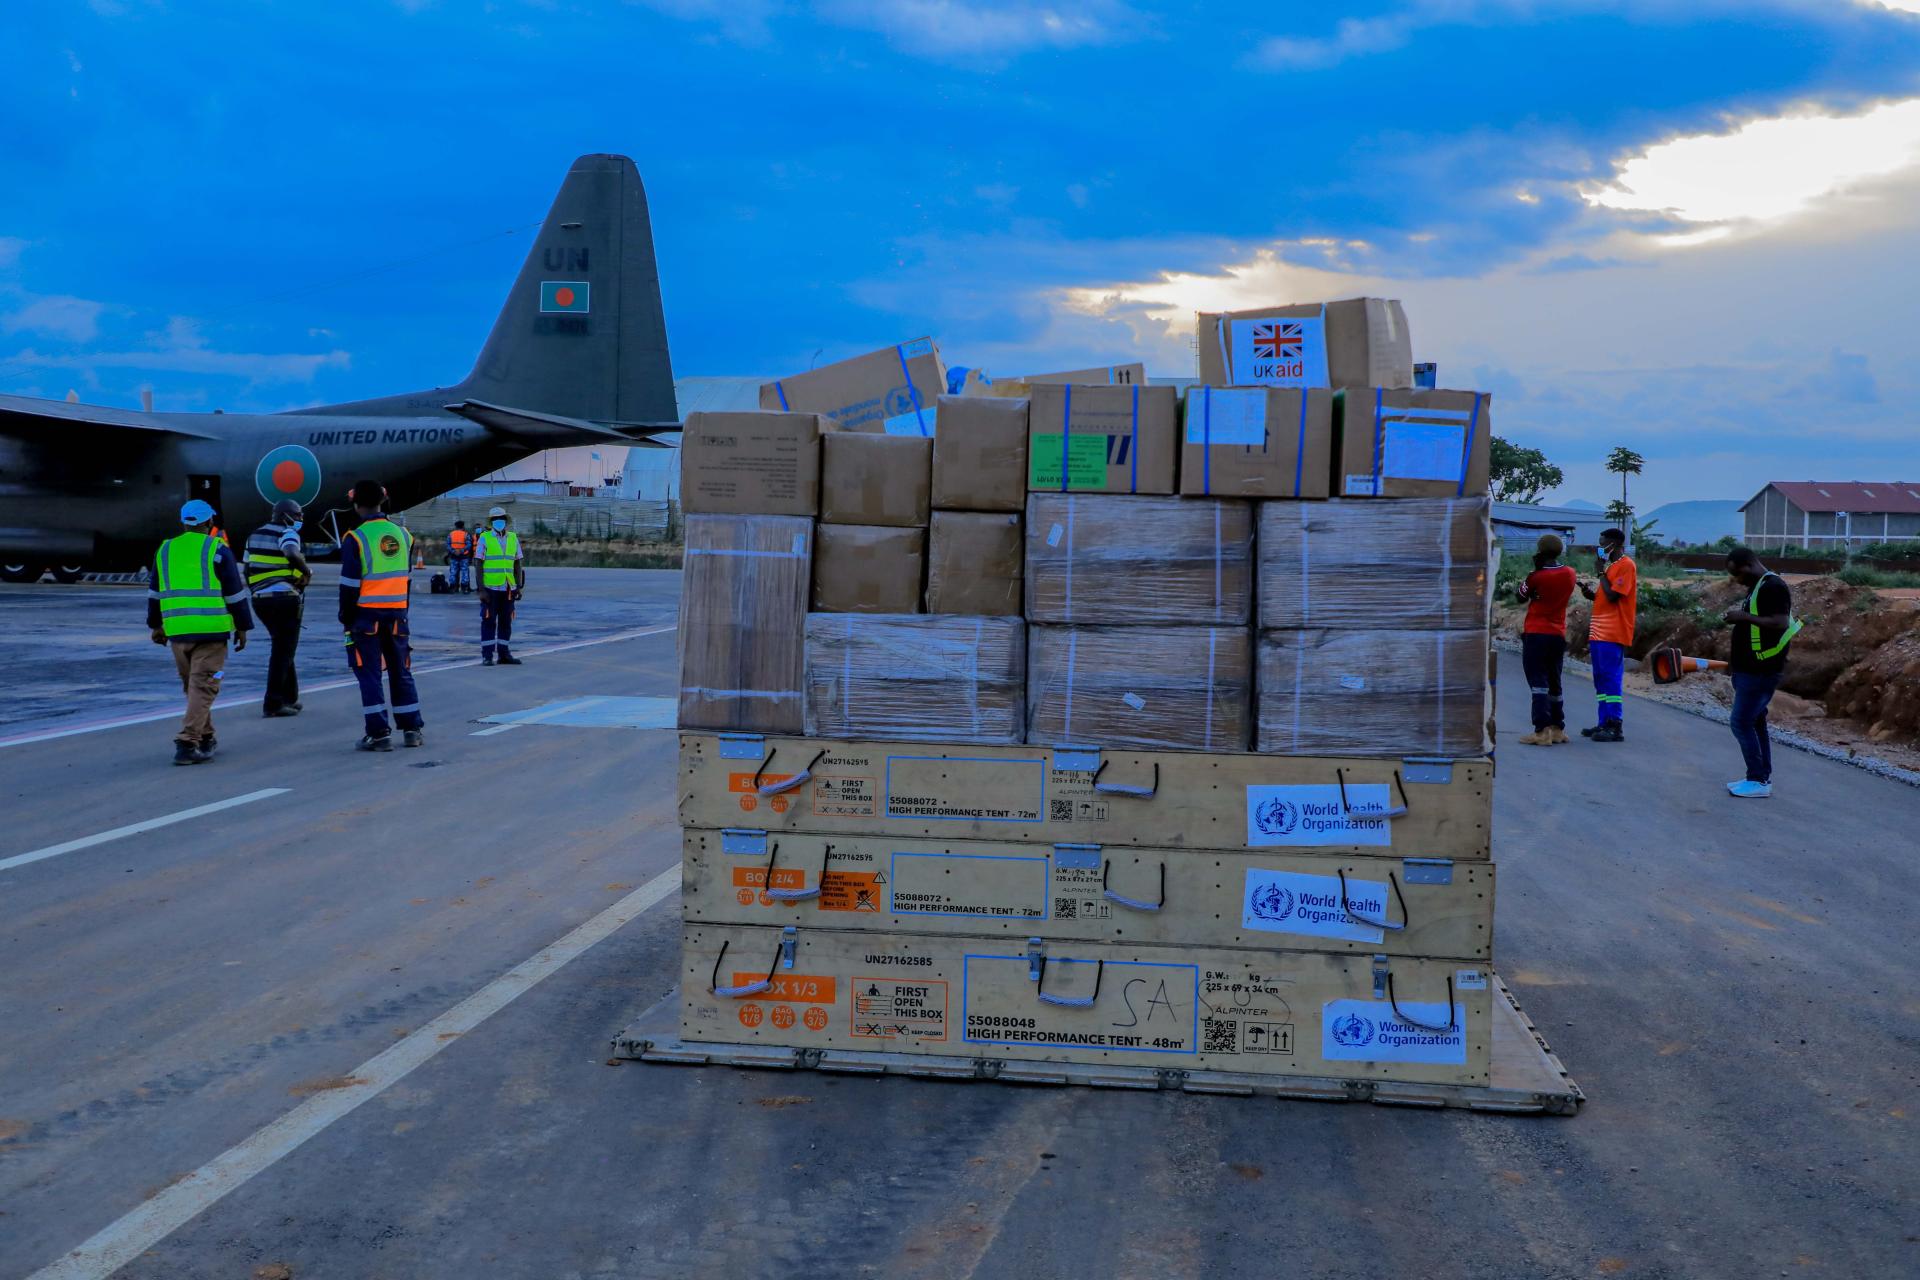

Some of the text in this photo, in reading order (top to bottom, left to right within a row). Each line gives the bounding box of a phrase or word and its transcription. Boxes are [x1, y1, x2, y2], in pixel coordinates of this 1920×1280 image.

[543, 247, 590, 272] UN
[308, 428, 464, 446] UNITED NATIONS
[889, 796, 937, 806] S5088072
[888, 806, 912, 814] HIGH
[914, 807, 983, 817] PERFORMANCE
[986, 809, 1010, 818] TENT
[1302, 802, 1338, 816] World
[1302, 816, 1384, 833] Organization
[776, 873, 794, 884] 2/4
[894, 892, 942, 902] S5088072
[1299, 892, 1336, 908] World
[894, 903, 917, 911] HIGH
[919, 904, 988, 914] PERFORMANCE
[991, 907, 1014, 915] TENT
[865, 955, 933, 966] UN27162585
[1249, 973, 1260, 982] kg
[792, 982, 817, 997] 1/3
[895, 986, 929, 997] FIRST
[1206, 983, 1222, 991] 225
[1231, 984, 1242, 992] 69
[1252, 985, 1263, 993] 34
[894, 998, 923, 1007] OPEN
[894, 1008, 943, 1019] THIS BOX
[1215, 1007, 1268, 1016] ALPINTER
[743, 1013, 760, 1023] 1/8
[775, 1015, 793, 1025] 2/8
[807, 1016, 825, 1027] 3/8
[968, 1015, 1036, 1028] S5088048
[967, 1028, 1000, 1039] HIGH
[1004, 1030, 1105, 1045] PERFORMANCE
[1108, 1035, 1142, 1047] TENT
[1378, 1033, 1460, 1047] Organization
